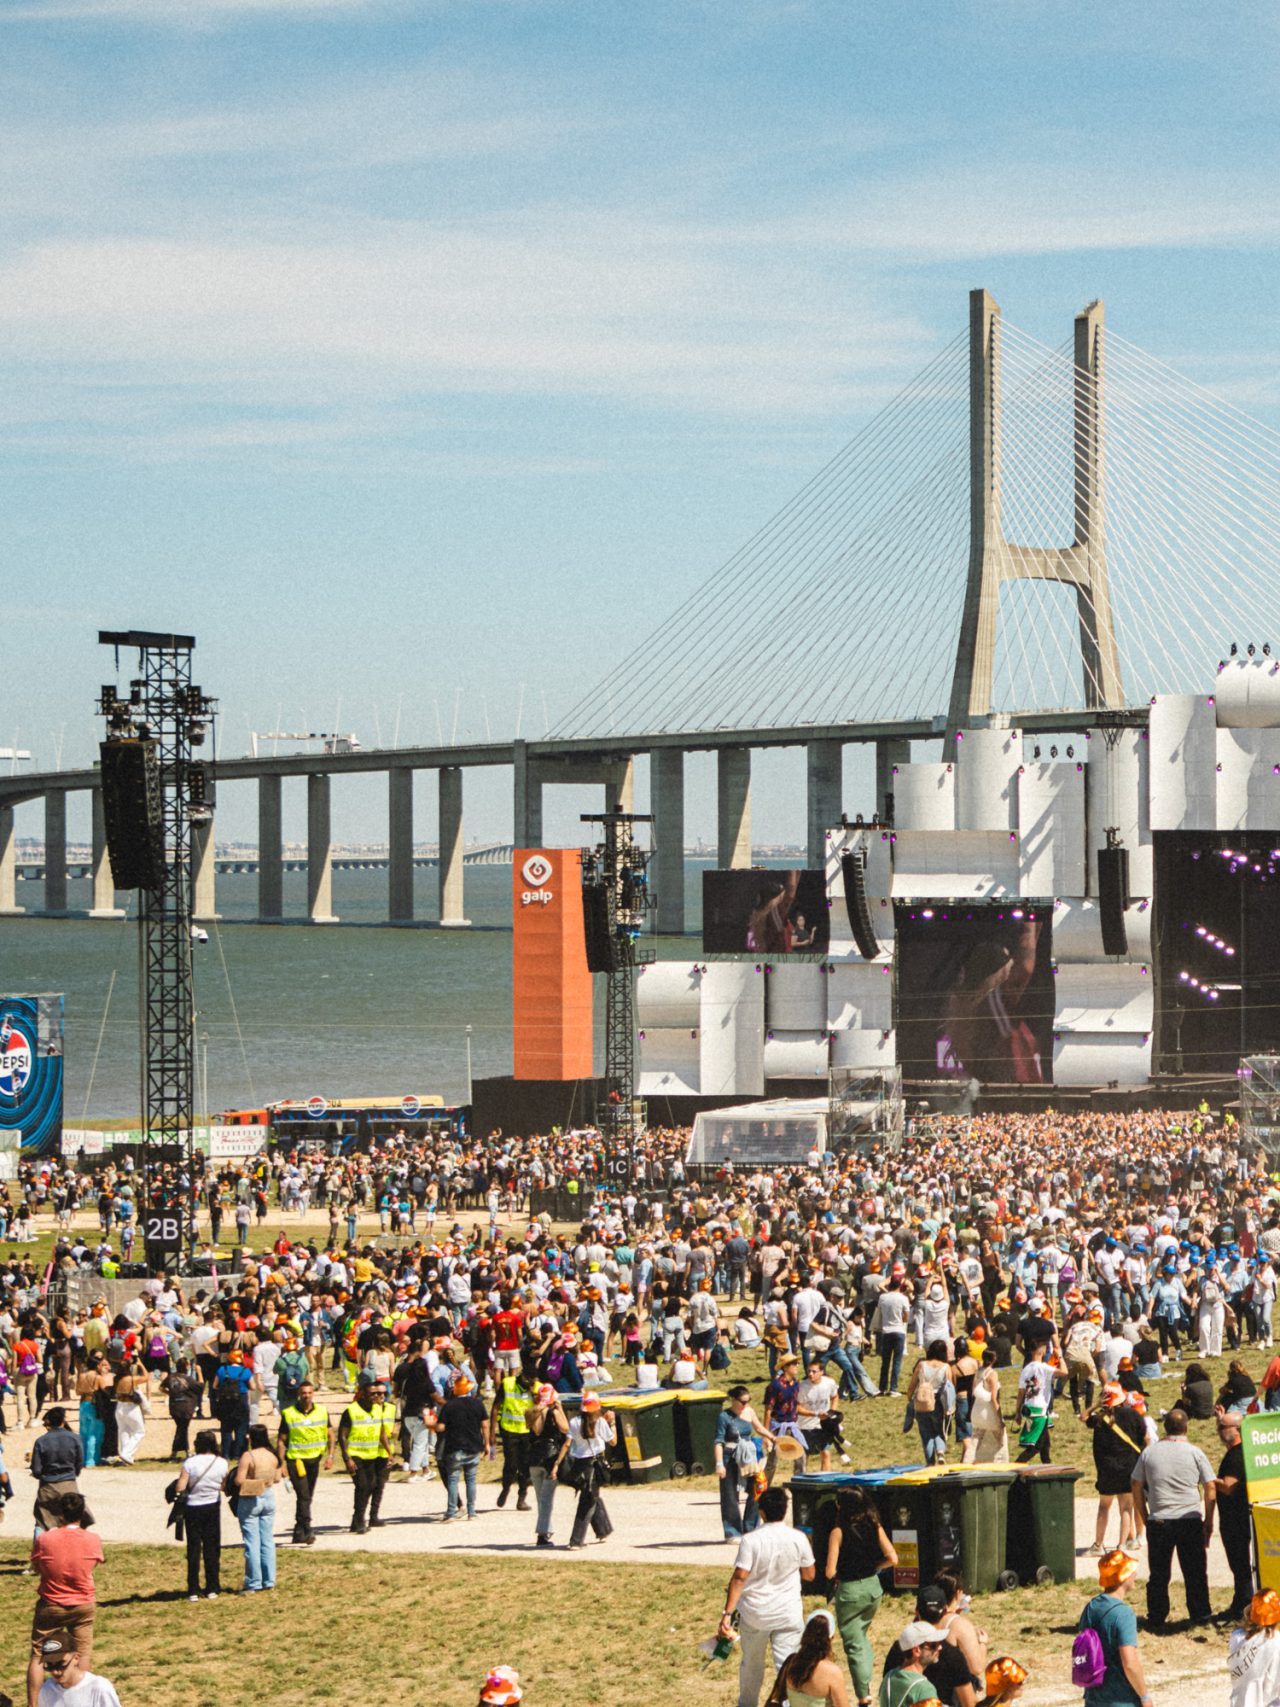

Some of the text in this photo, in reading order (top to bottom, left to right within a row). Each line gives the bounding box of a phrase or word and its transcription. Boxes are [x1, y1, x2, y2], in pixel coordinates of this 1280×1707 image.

[522, 889, 553, 904] galp
[608, 1160, 627, 1175] 1C
[147, 1216, 179, 1241] 2B
[1254, 1454, 1269, 1467] no
